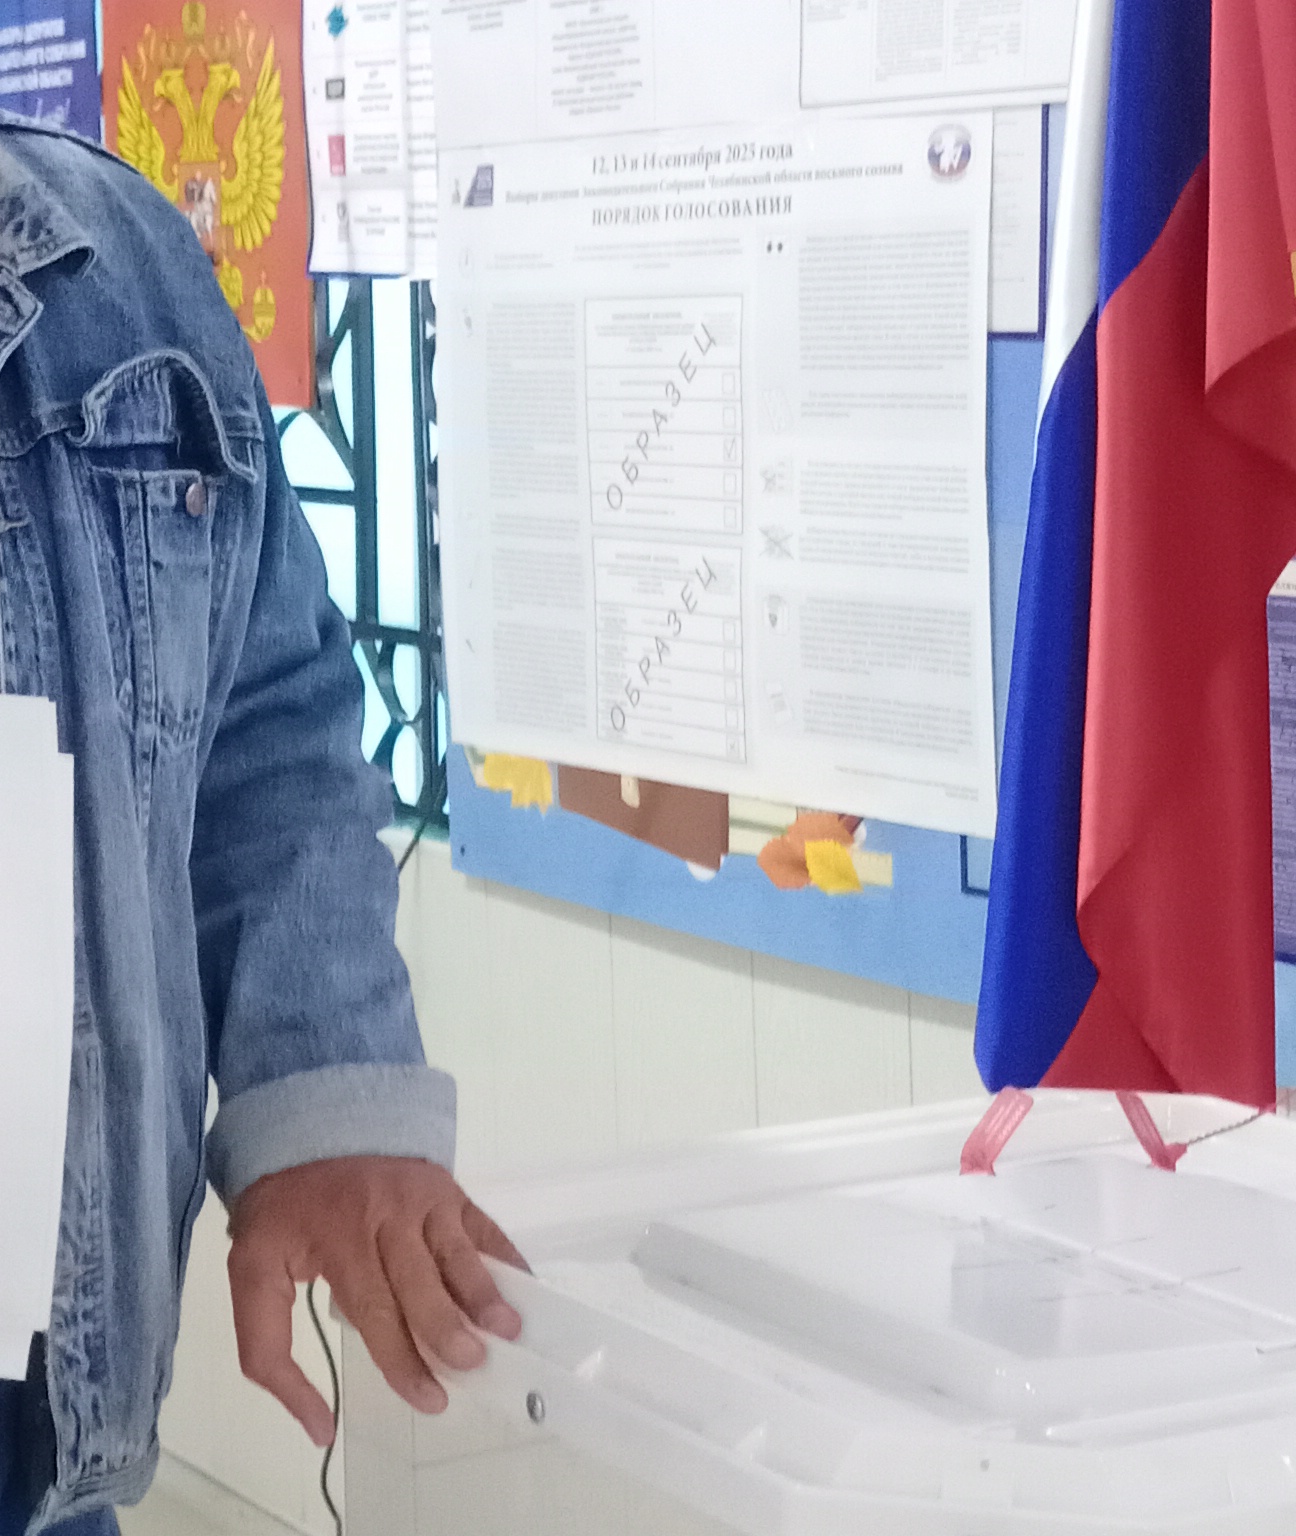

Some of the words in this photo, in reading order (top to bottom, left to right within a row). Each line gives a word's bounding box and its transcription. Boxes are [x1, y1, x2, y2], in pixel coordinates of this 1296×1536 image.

[658, 146, 722, 172] сентября
[725, 142, 756, 164] 2025
[759, 142, 793, 163] года
[592, 205, 661, 227] ПОРЯДОК
[664, 195, 793, 222] ГОЛОСОВАНИЯ
[606, 322, 717, 511] ОБРАЗЕЦ
[610, 555, 718, 733] ОБРАЗЕЦ
